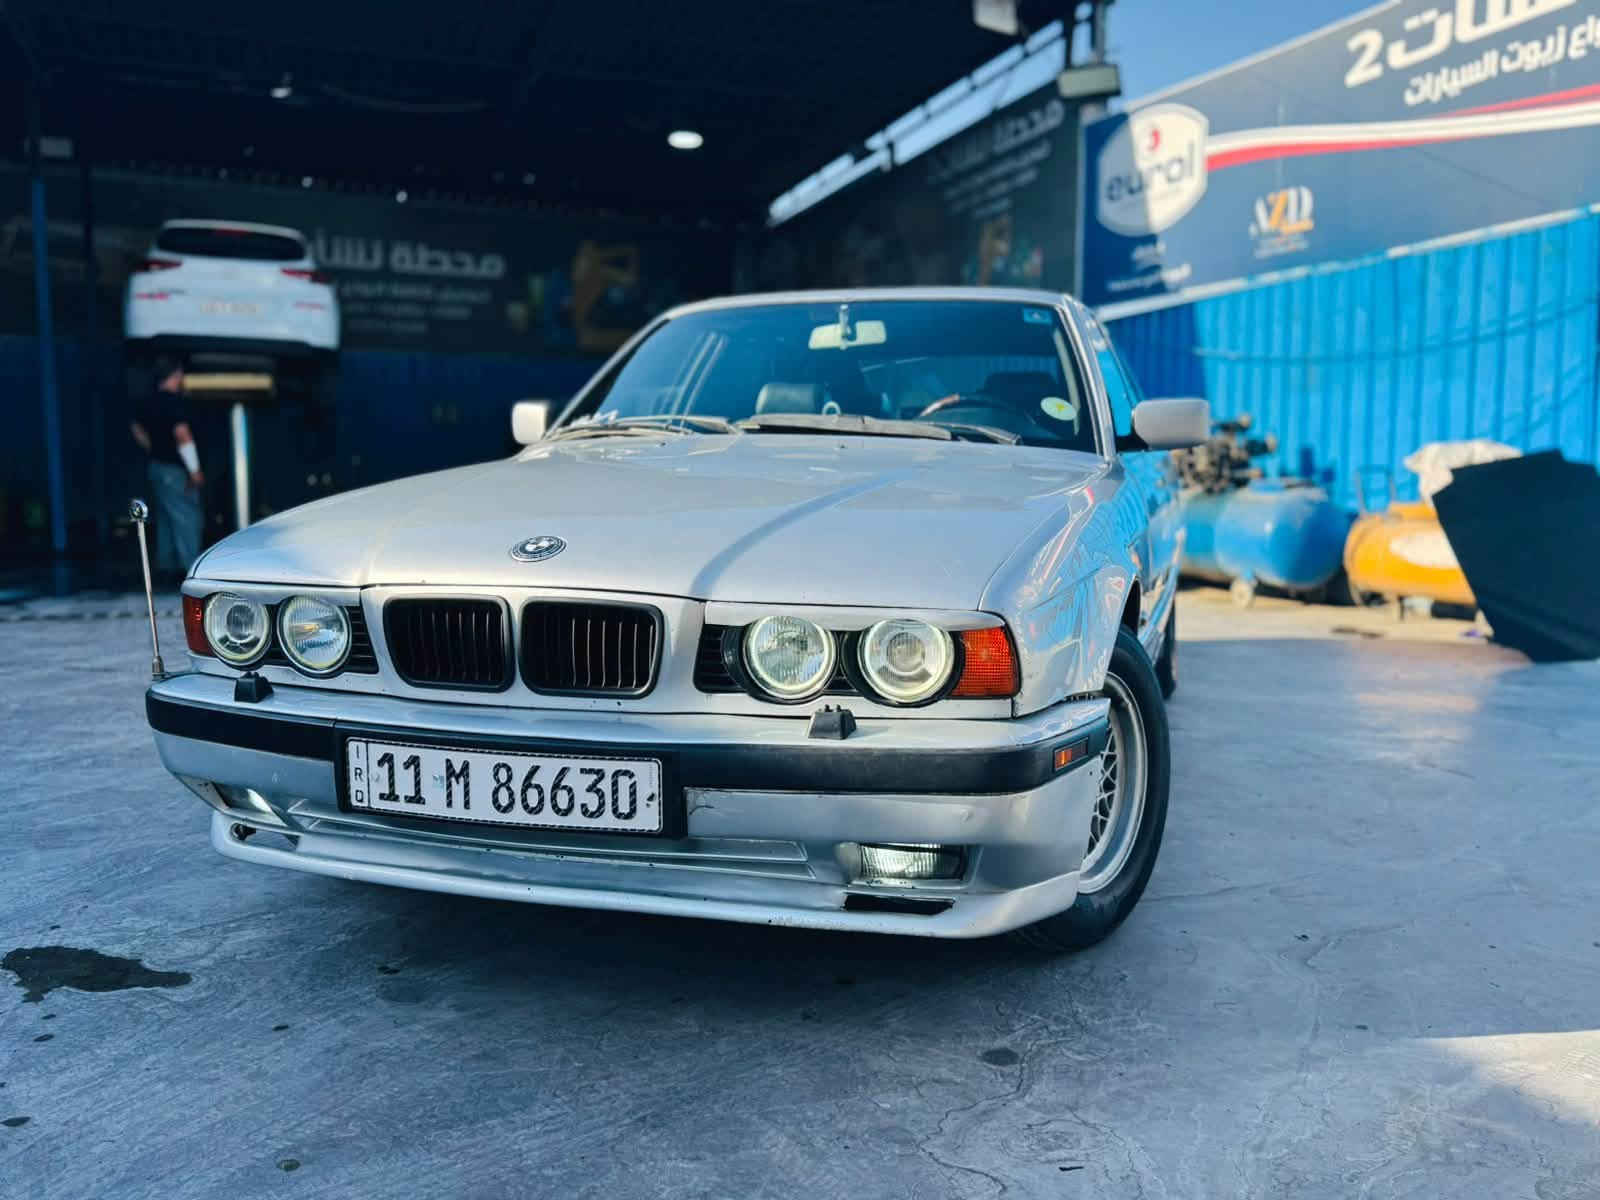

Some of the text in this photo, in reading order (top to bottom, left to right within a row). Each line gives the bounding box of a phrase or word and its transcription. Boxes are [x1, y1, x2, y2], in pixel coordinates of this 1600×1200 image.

[1344, 29, 1384, 88] 2
[1404, 49, 1499, 106] السيارات
[377, 752, 426, 805] 11
[445, 758, 470, 810] M
[491, 762, 637, 820] 86630
